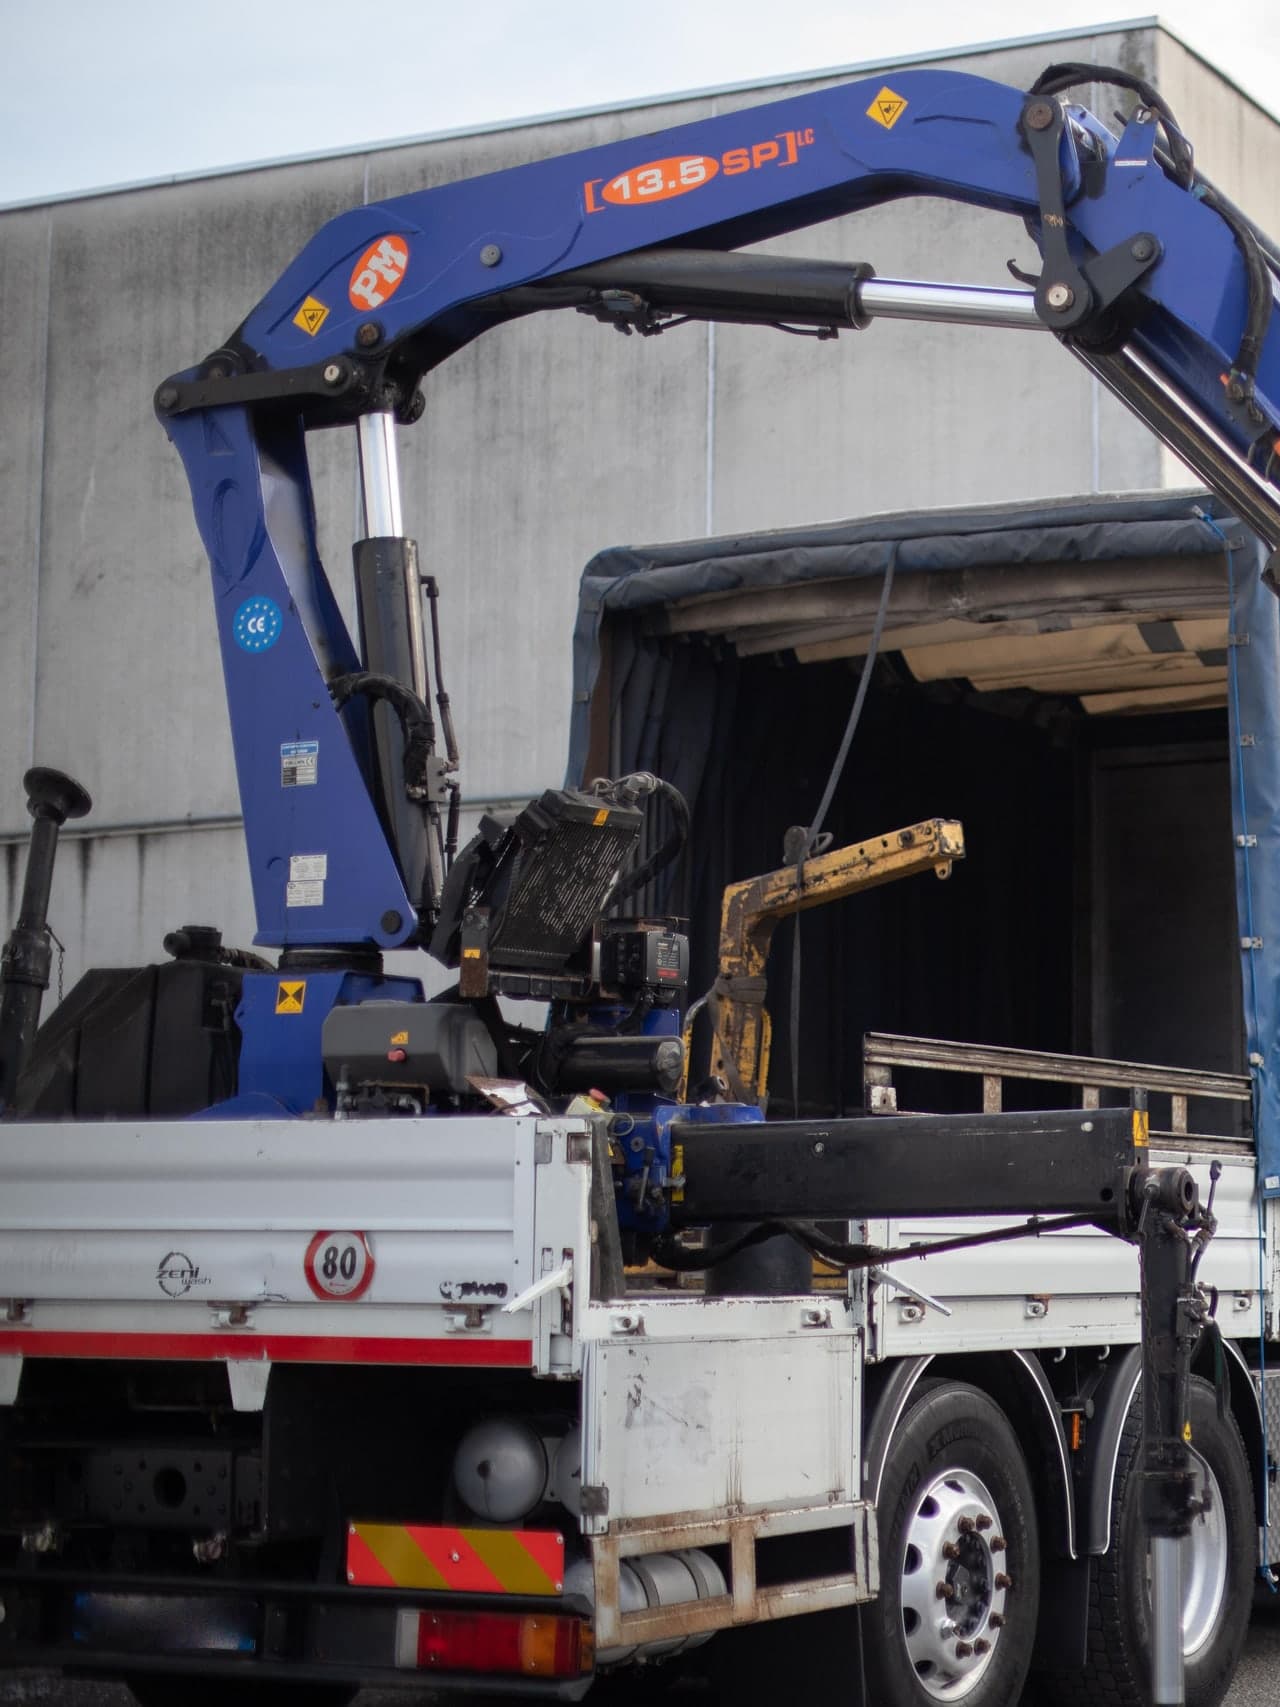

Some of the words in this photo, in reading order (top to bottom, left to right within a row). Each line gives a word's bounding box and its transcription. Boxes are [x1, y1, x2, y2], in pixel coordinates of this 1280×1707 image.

[351, 239, 408, 308] PM
[247, 616, 265, 634] CE
[322, 1246, 357, 1281] 80
